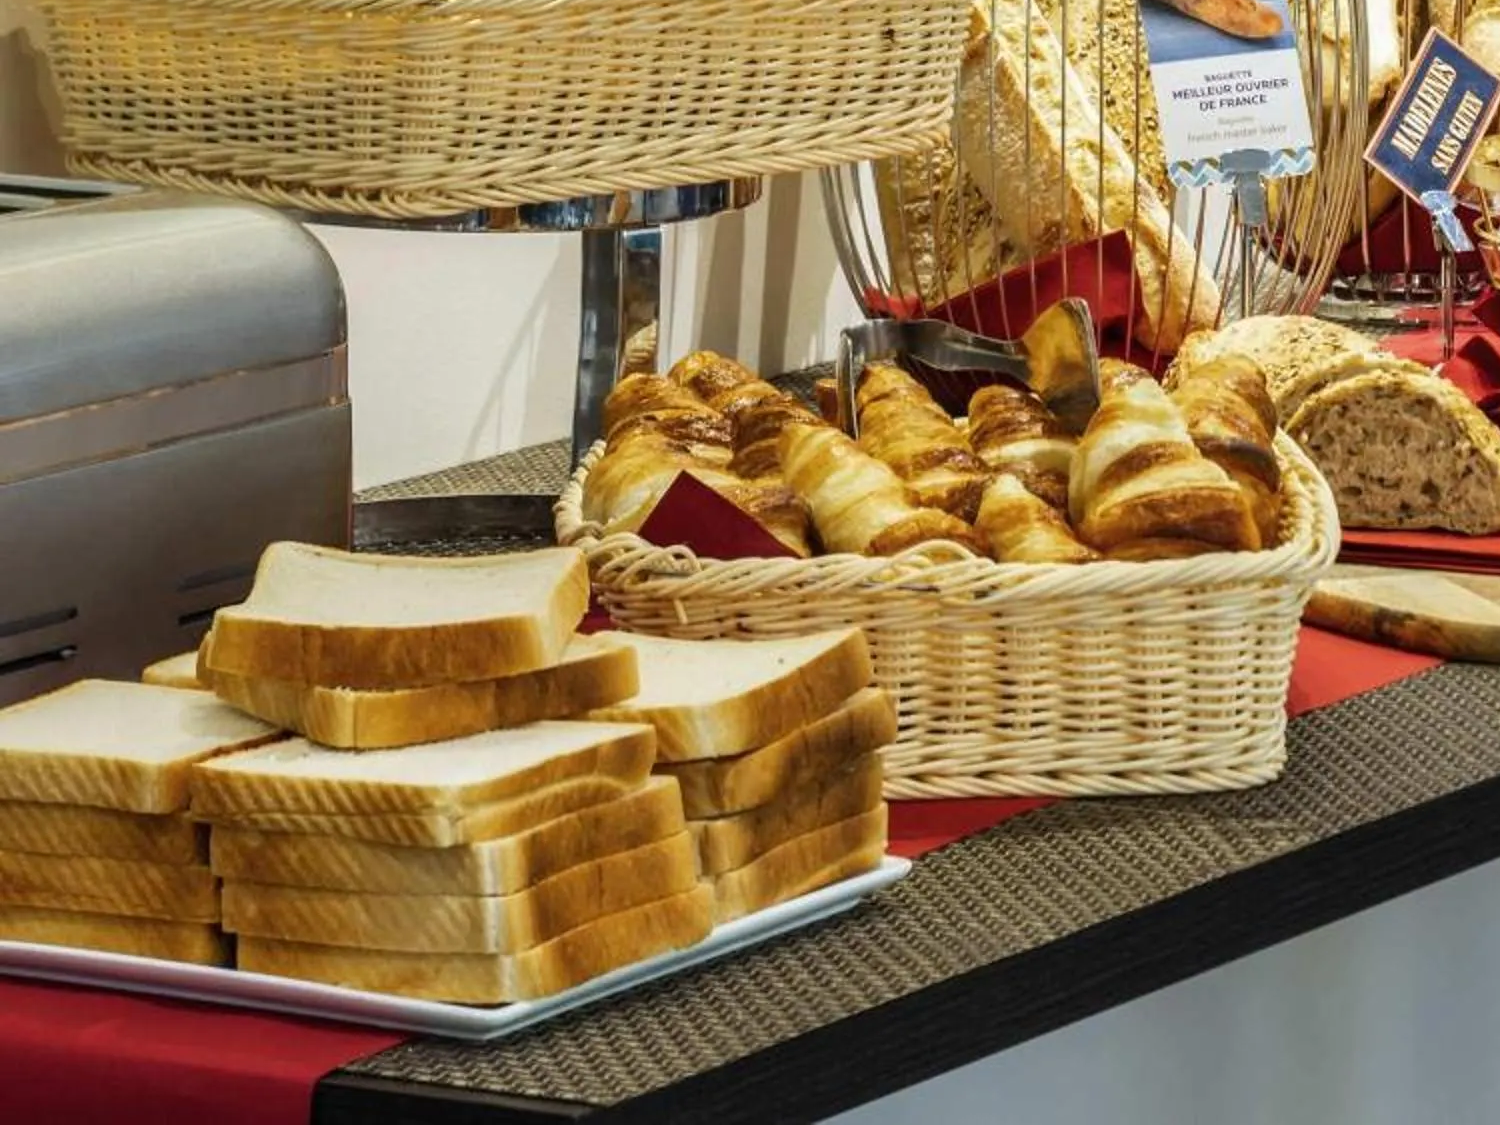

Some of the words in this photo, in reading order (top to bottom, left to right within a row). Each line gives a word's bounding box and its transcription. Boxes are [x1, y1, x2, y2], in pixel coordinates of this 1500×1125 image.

[1172, 84, 1233, 100] MEILLEUR
[1235, 77, 1290, 94] OUVRIER
[1199, 101, 1217, 112] DE
[1219, 93, 1268, 109] FRANCE
[1391, 56, 1456, 161] MADELEINES
[1431, 133, 1462, 175] SANS
[1449, 90, 1483, 141] GLUTEN
